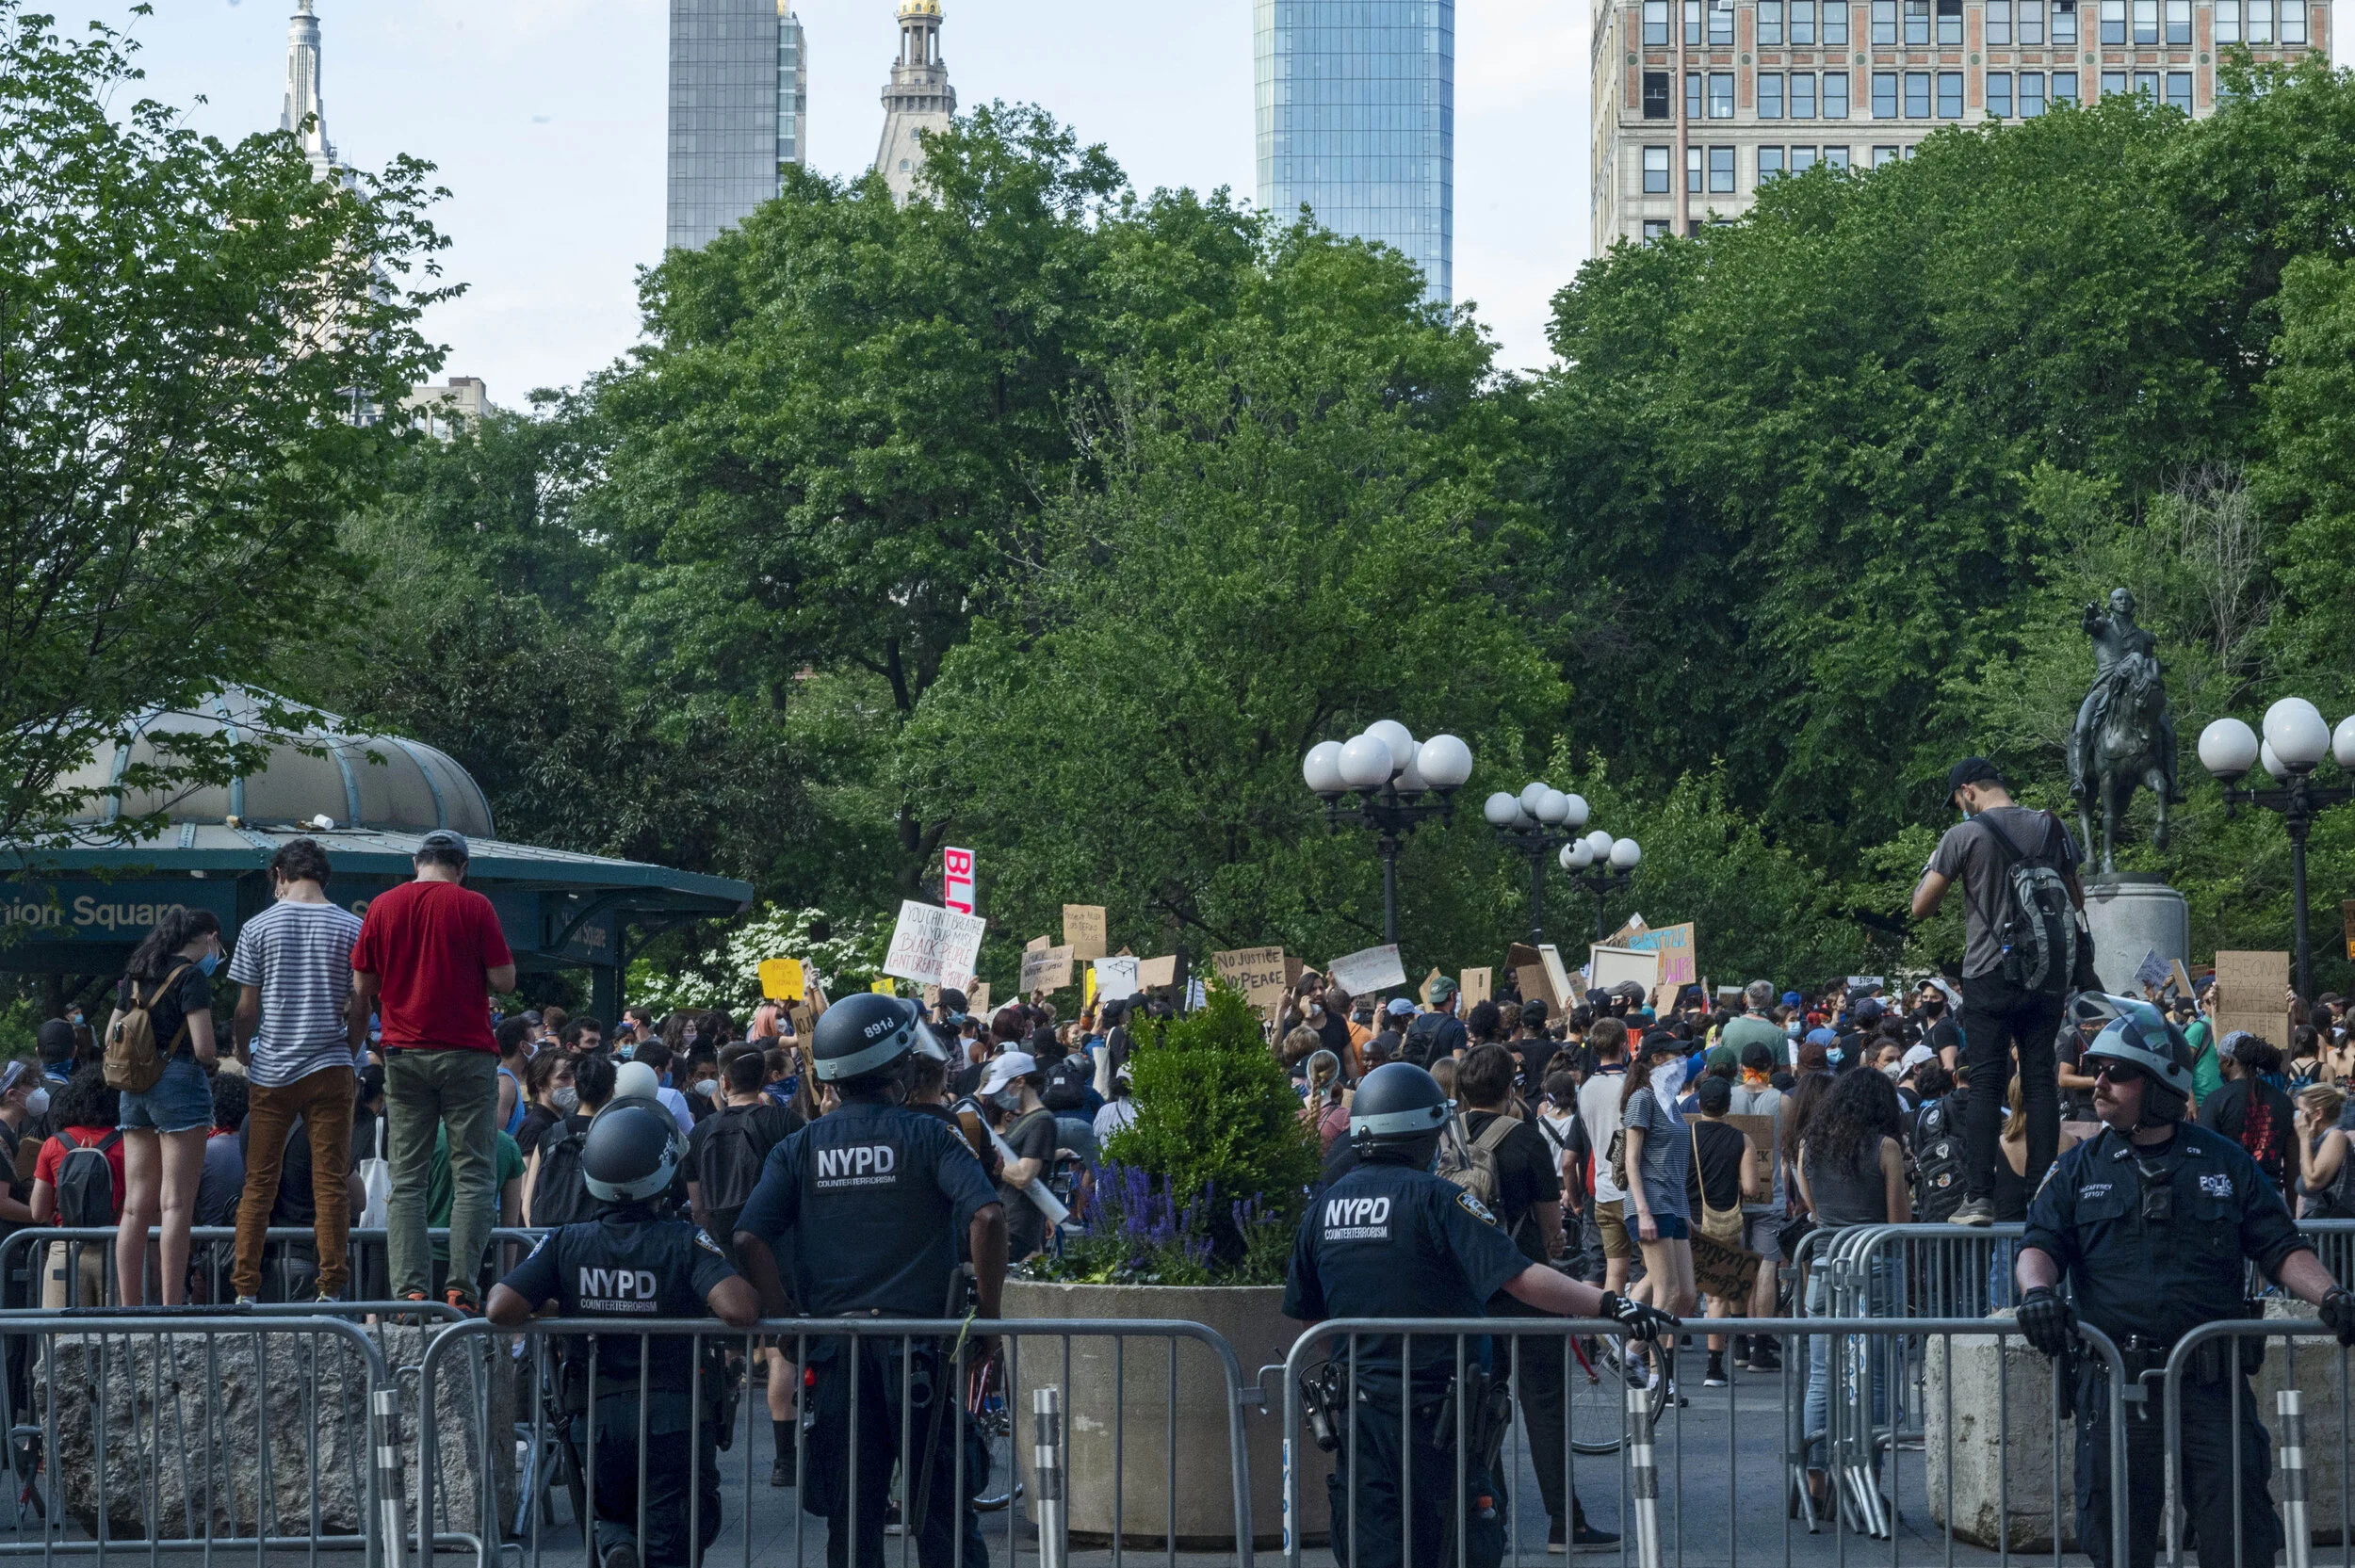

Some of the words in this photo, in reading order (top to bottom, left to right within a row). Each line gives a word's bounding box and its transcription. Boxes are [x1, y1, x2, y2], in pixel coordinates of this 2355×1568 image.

[907, 906, 924, 923] YOU
[950, 914, 983, 935] BREATHE
[918, 926, 928, 936] IN
[930, 926, 951, 942] YOUR
[952, 931, 975, 947] MASK
[1628, 927, 1687, 951] BATTLE
[898, 932, 938, 957] BLACK
[939, 943, 972, 967] PEOPLE
[1217, 955, 1235, 971] NO
[1238, 948, 1281, 966] JUSTICE
[911, 955, 944, 976] BREATHE
[2217, 957, 2288, 978] BREONNA
[1241, 971, 1284, 990] PEACE
[2221, 979, 2287, 998] TAYLOR
[818, 1145, 895, 1177] NYPD
[817, 1175, 896, 1188] COUNTERTERRORISM
[1324, 1197, 1390, 1227] NYPD
[1324, 1226, 1388, 1240] COUNTERTERRORISM
[579, 1267, 657, 1299] NYPD
[580, 1299, 658, 1312] COUNTERTERRORISM
